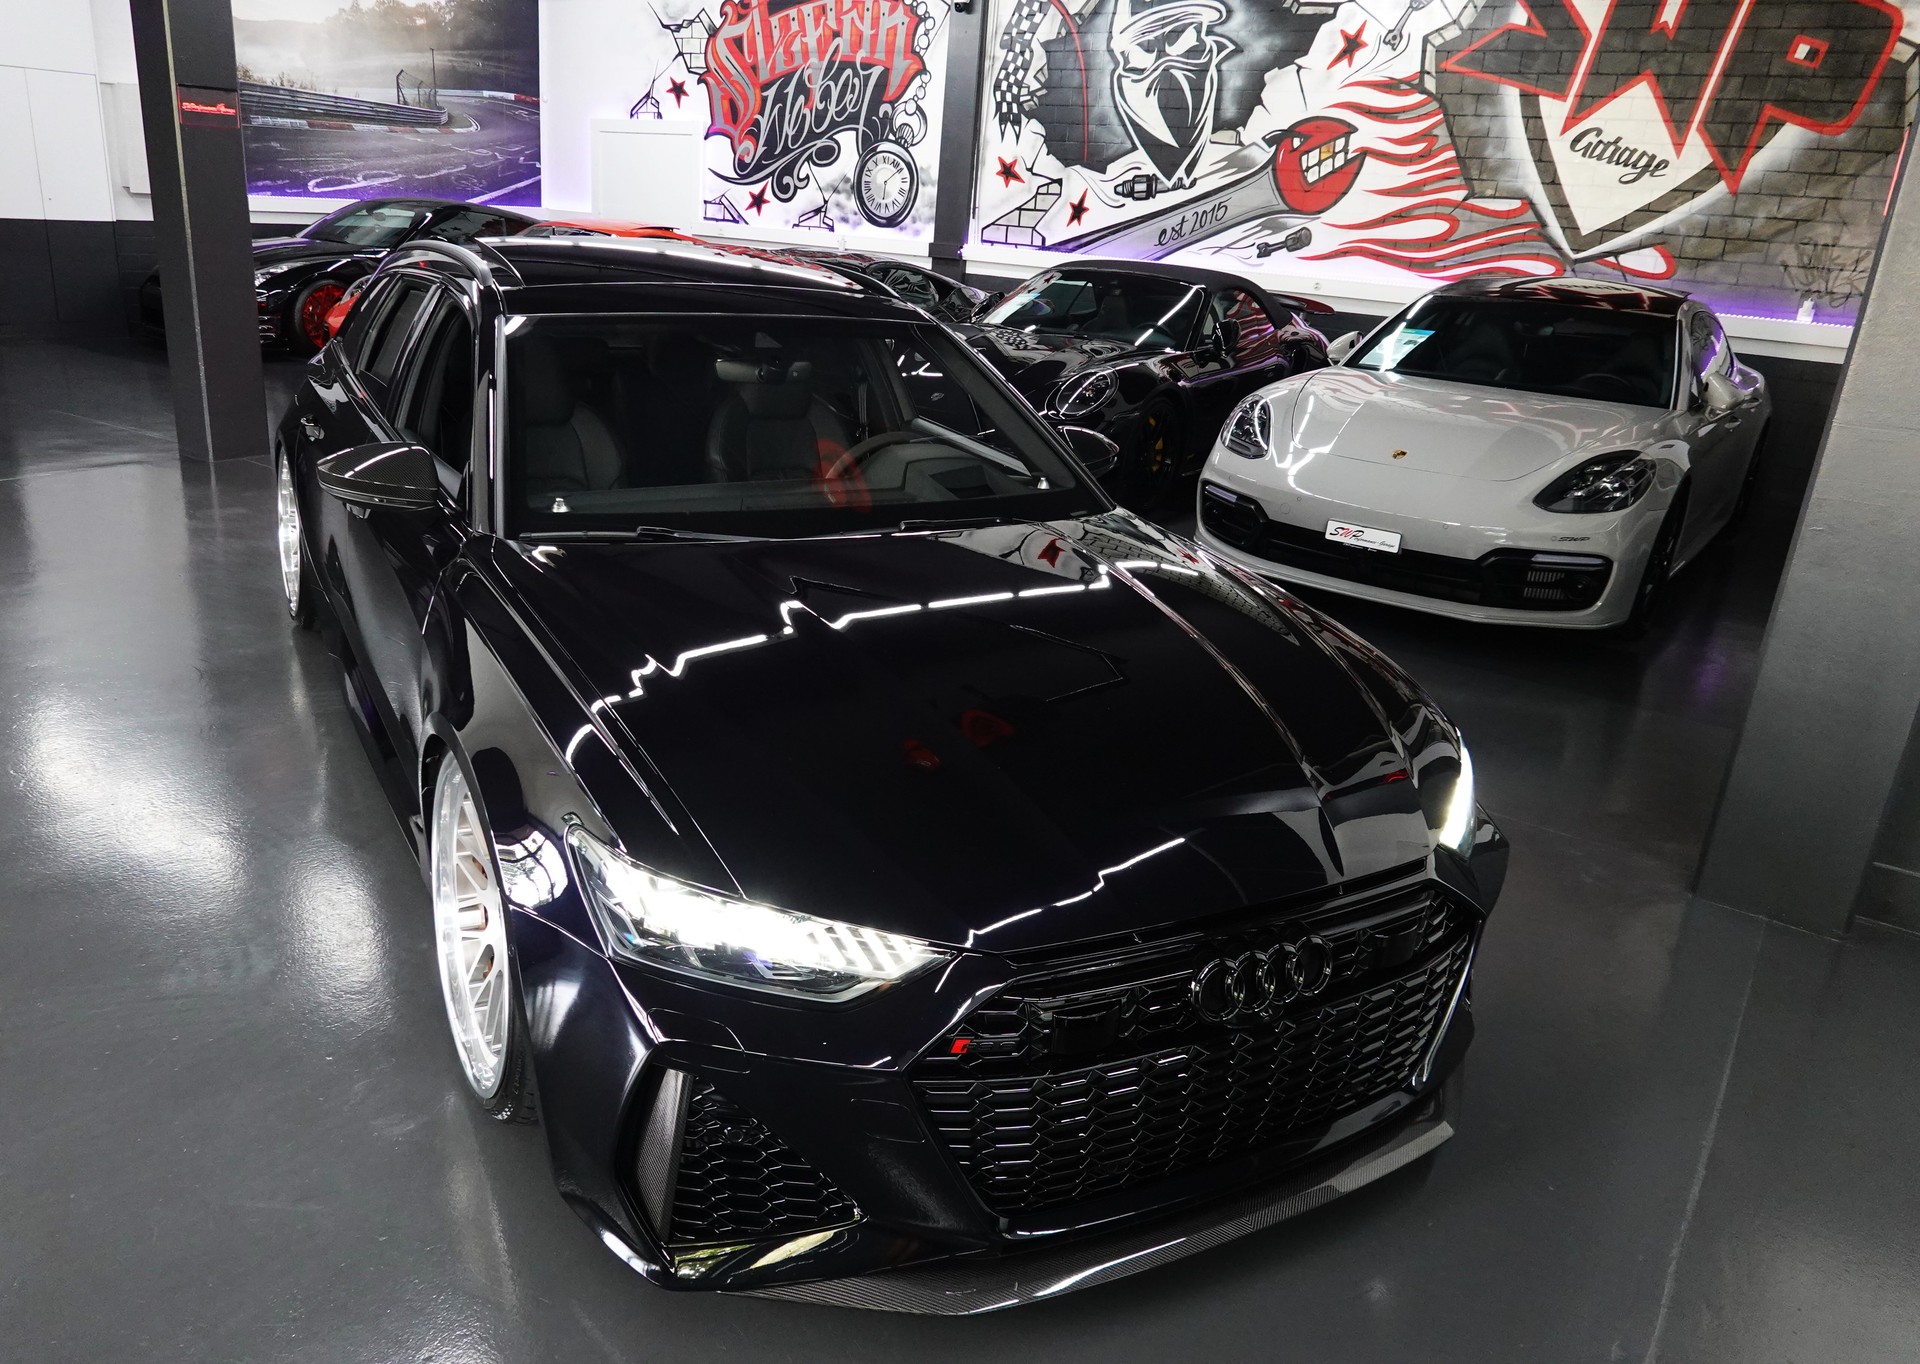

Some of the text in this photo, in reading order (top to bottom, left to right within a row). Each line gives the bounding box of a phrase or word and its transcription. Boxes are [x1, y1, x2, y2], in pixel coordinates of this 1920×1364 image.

[1569, 127, 1670, 185] Garage
[1154, 197, 1232, 246] est 2015
